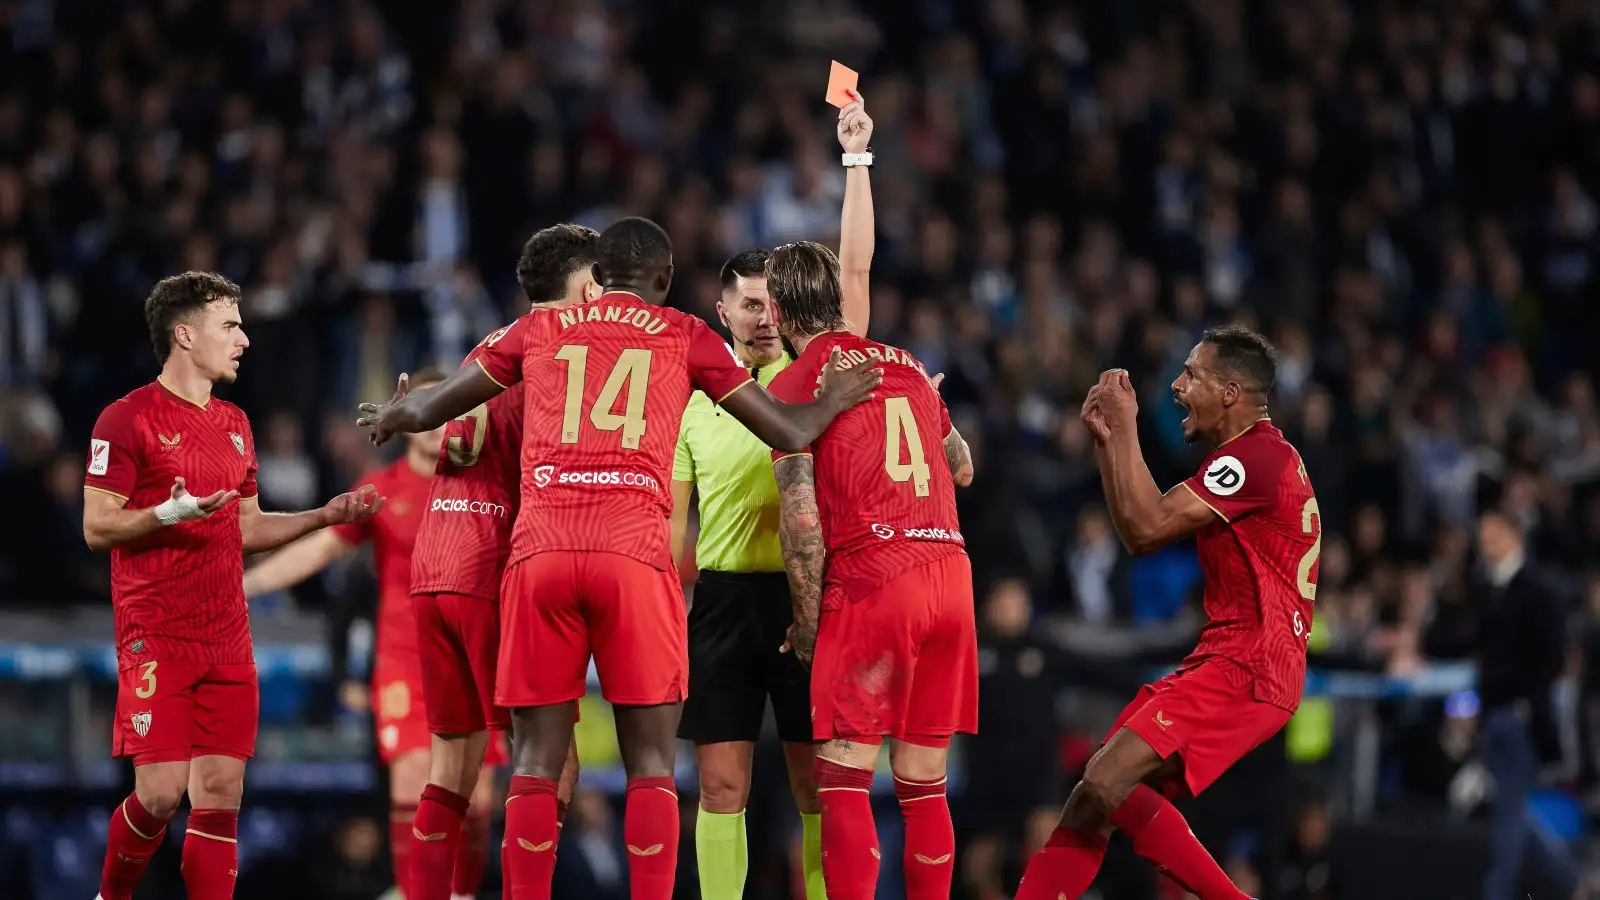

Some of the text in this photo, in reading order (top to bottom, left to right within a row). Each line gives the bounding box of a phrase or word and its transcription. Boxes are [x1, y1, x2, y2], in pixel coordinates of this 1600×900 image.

[558, 305, 667, 334] NIANZOU
[554, 344, 653, 450] 14
[885, 397, 930, 497] 4
[1207, 464, 1240, 488] JD
[431, 499, 505, 517] OCIOS.com
[135, 660, 159, 699] 3
